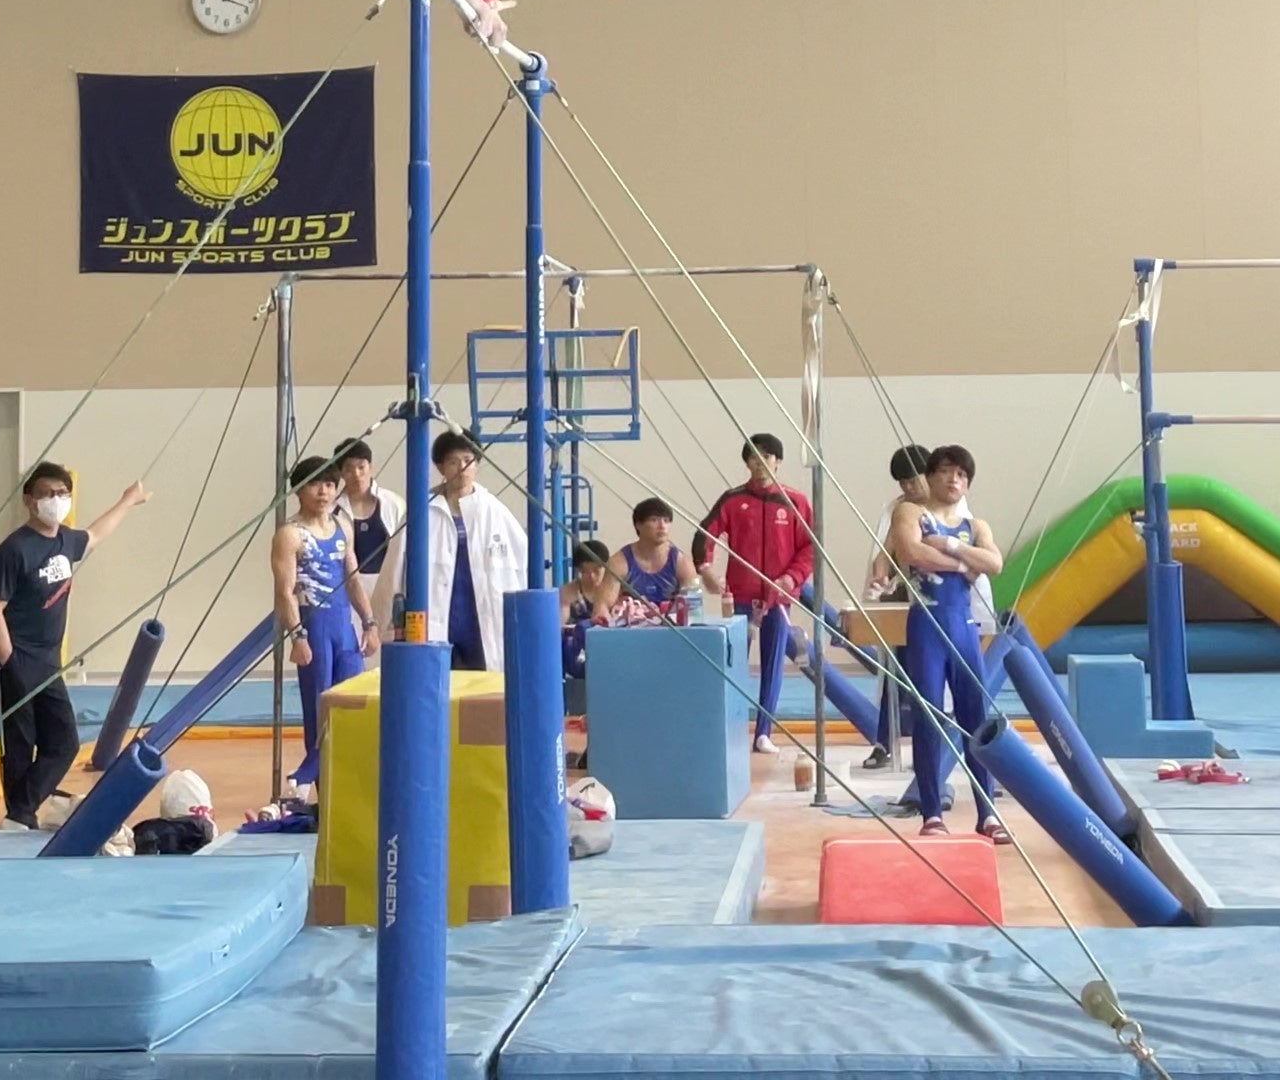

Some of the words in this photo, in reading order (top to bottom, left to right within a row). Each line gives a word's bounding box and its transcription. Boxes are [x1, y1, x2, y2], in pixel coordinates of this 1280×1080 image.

[214, 15, 219, 24] 7
[224, 18, 230, 27] 6
[236, 14, 241, 24] 5
[179, 131, 275, 157] JUN
[243, 177, 279, 206] CLUB
[121, 250, 165, 263] JUN
[172, 250, 265, 264] SPORTS
[272, 246, 331, 260] CLUB
[1085, 817, 1124, 865] YONEDA
[386, 833, 400, 929] YONEDA
